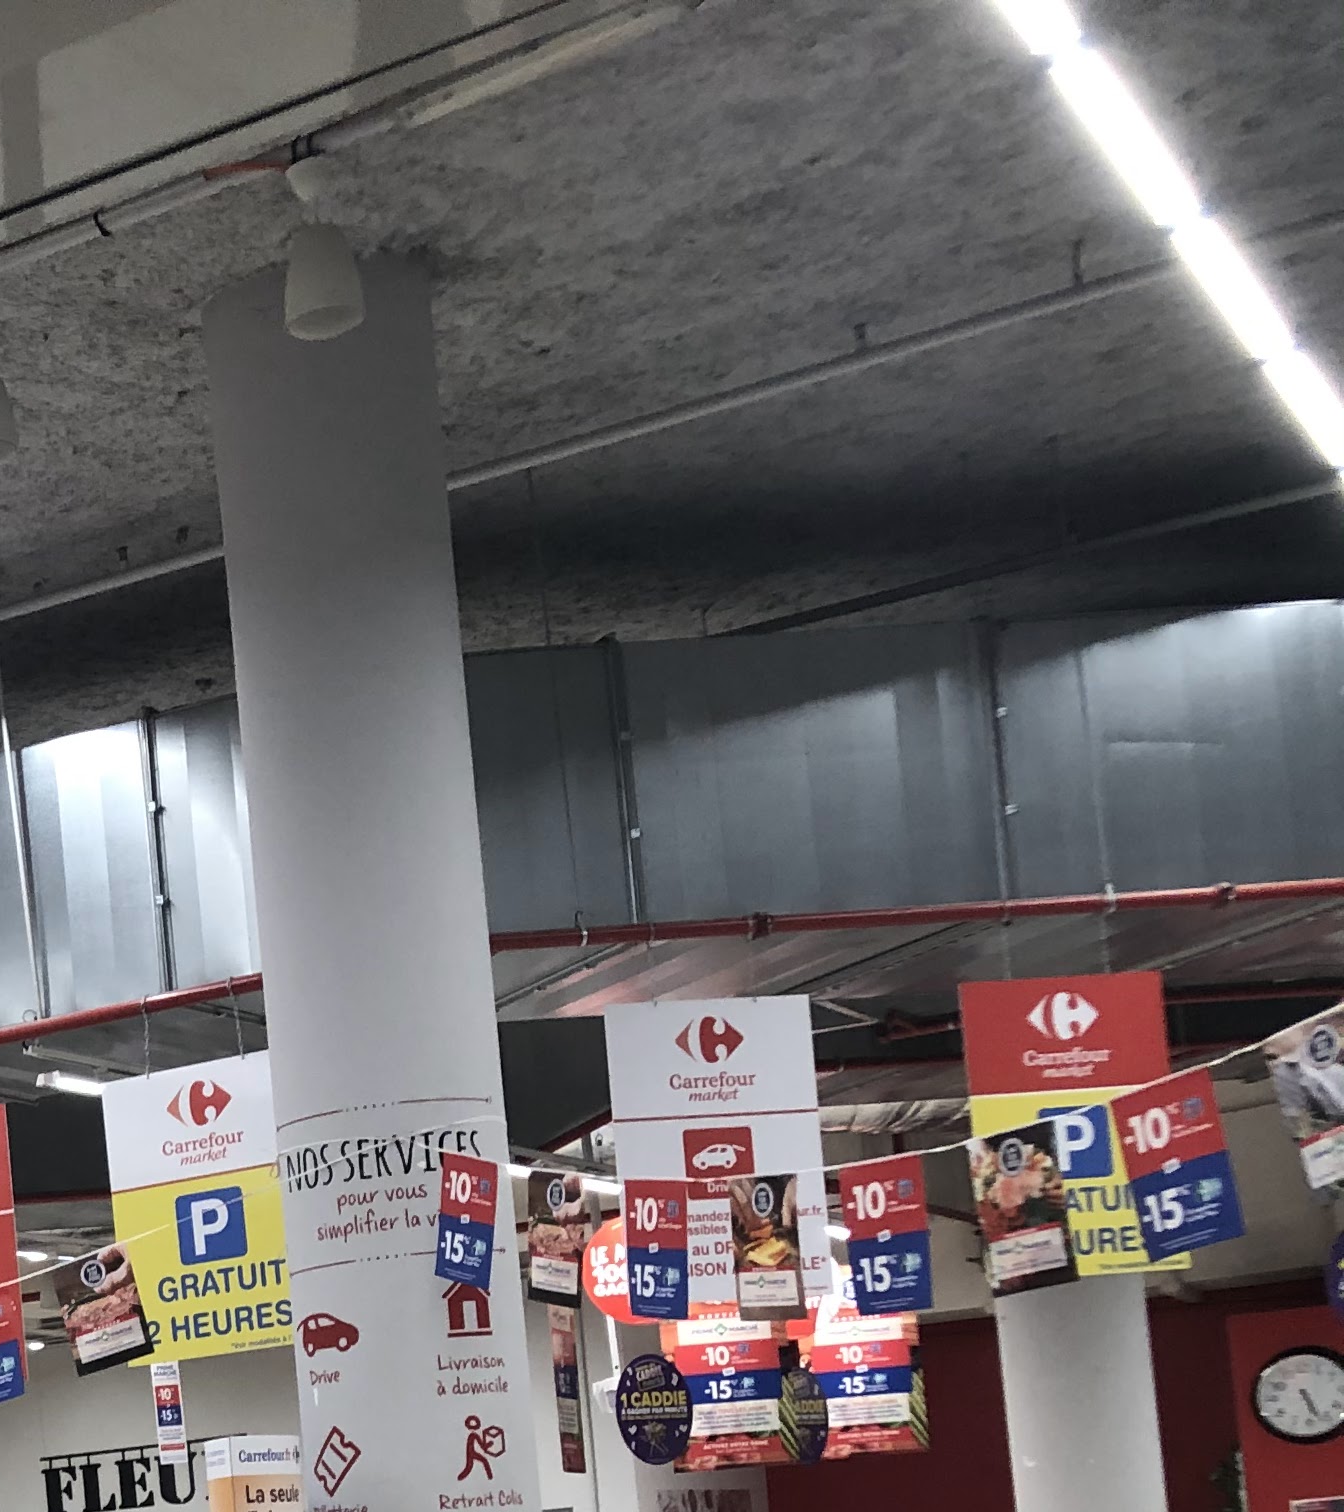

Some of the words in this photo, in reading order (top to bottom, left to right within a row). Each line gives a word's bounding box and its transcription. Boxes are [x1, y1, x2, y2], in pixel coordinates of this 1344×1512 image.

[1023, 1047, 1112, 1067] Carrefour
[669, 1071, 756, 1090] Carrefour
[689, 1088, 739, 1102] market
[162, 1131, 244, 1156] Carrefour
[1054, 1114, 1095, 1172] P
[180, 1147, 227, 1166] market
[286, 1147, 334, 1193] NOS
[707, 1182, 730, 1193] Driv
[336, 1189, 378, 1214] pour
[385, 1183, 428, 1201] vous
[190, 1198, 229, 1256] P
[317, 1208, 399, 1243] simplifier
[405, 1209, 421, 1227] la
[590, 1246, 610, 1267] LE
[692, 1244, 710, 1255] au
[158, 1258, 287, 1303] GRATUIT
[171, 1300, 293, 1343] HEURES
[437, 1354, 505, 1371] Livraison
[310, 1370, 340, 1386] Drive
[436, 1380, 446, 1396] à
[452, 1376, 509, 1395] domicile
[620, 1392, 628, 1408] 1
[631, 1390, 688, 1407] CADDIE
[245, 1485, 264, 1504] La
[270, 1484, 299, 1503] seule
[438, 1491, 494, 1510] Retrait
[498, 1489, 524, 1508] Colis
